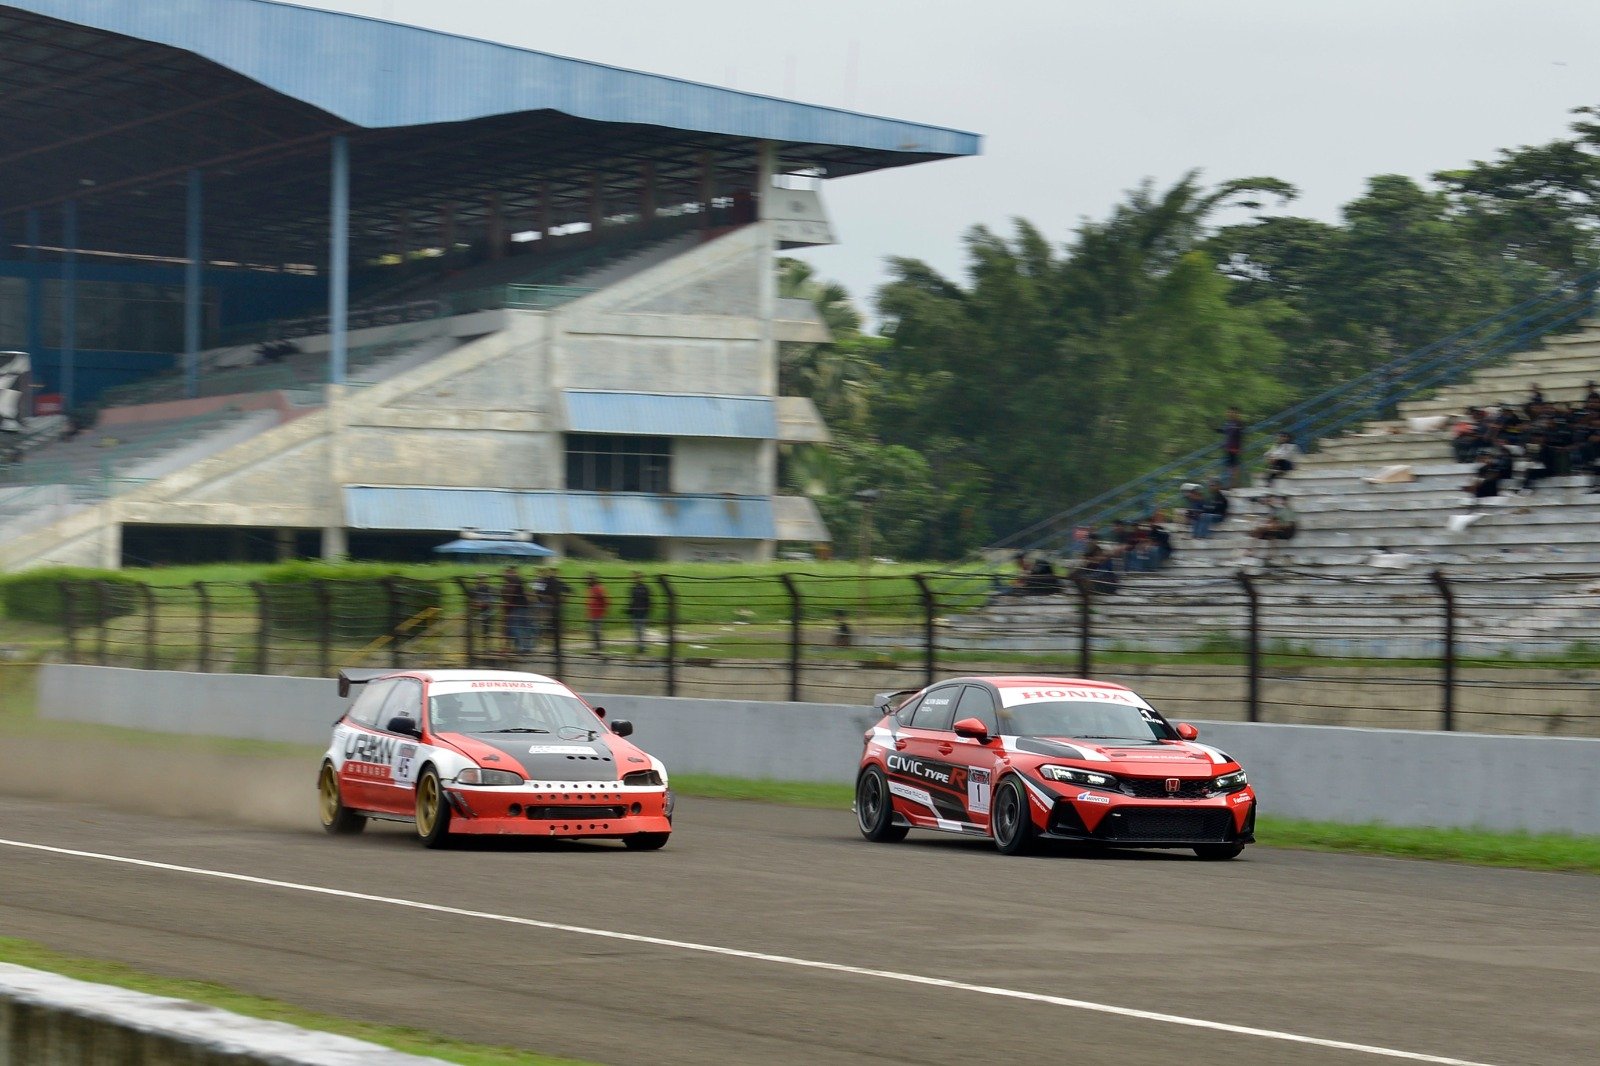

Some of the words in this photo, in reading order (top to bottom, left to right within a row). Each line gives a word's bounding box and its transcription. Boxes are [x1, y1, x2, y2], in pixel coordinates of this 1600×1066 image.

[471, 681, 533, 689] ABUNAWAS
[1022, 690, 1133, 703] HONDA
[887, 755, 923, 776] CIVIC
[924, 768, 950, 783] TYPE
[948, 767, 967, 791] R
[976, 783, 981, 803] 1
